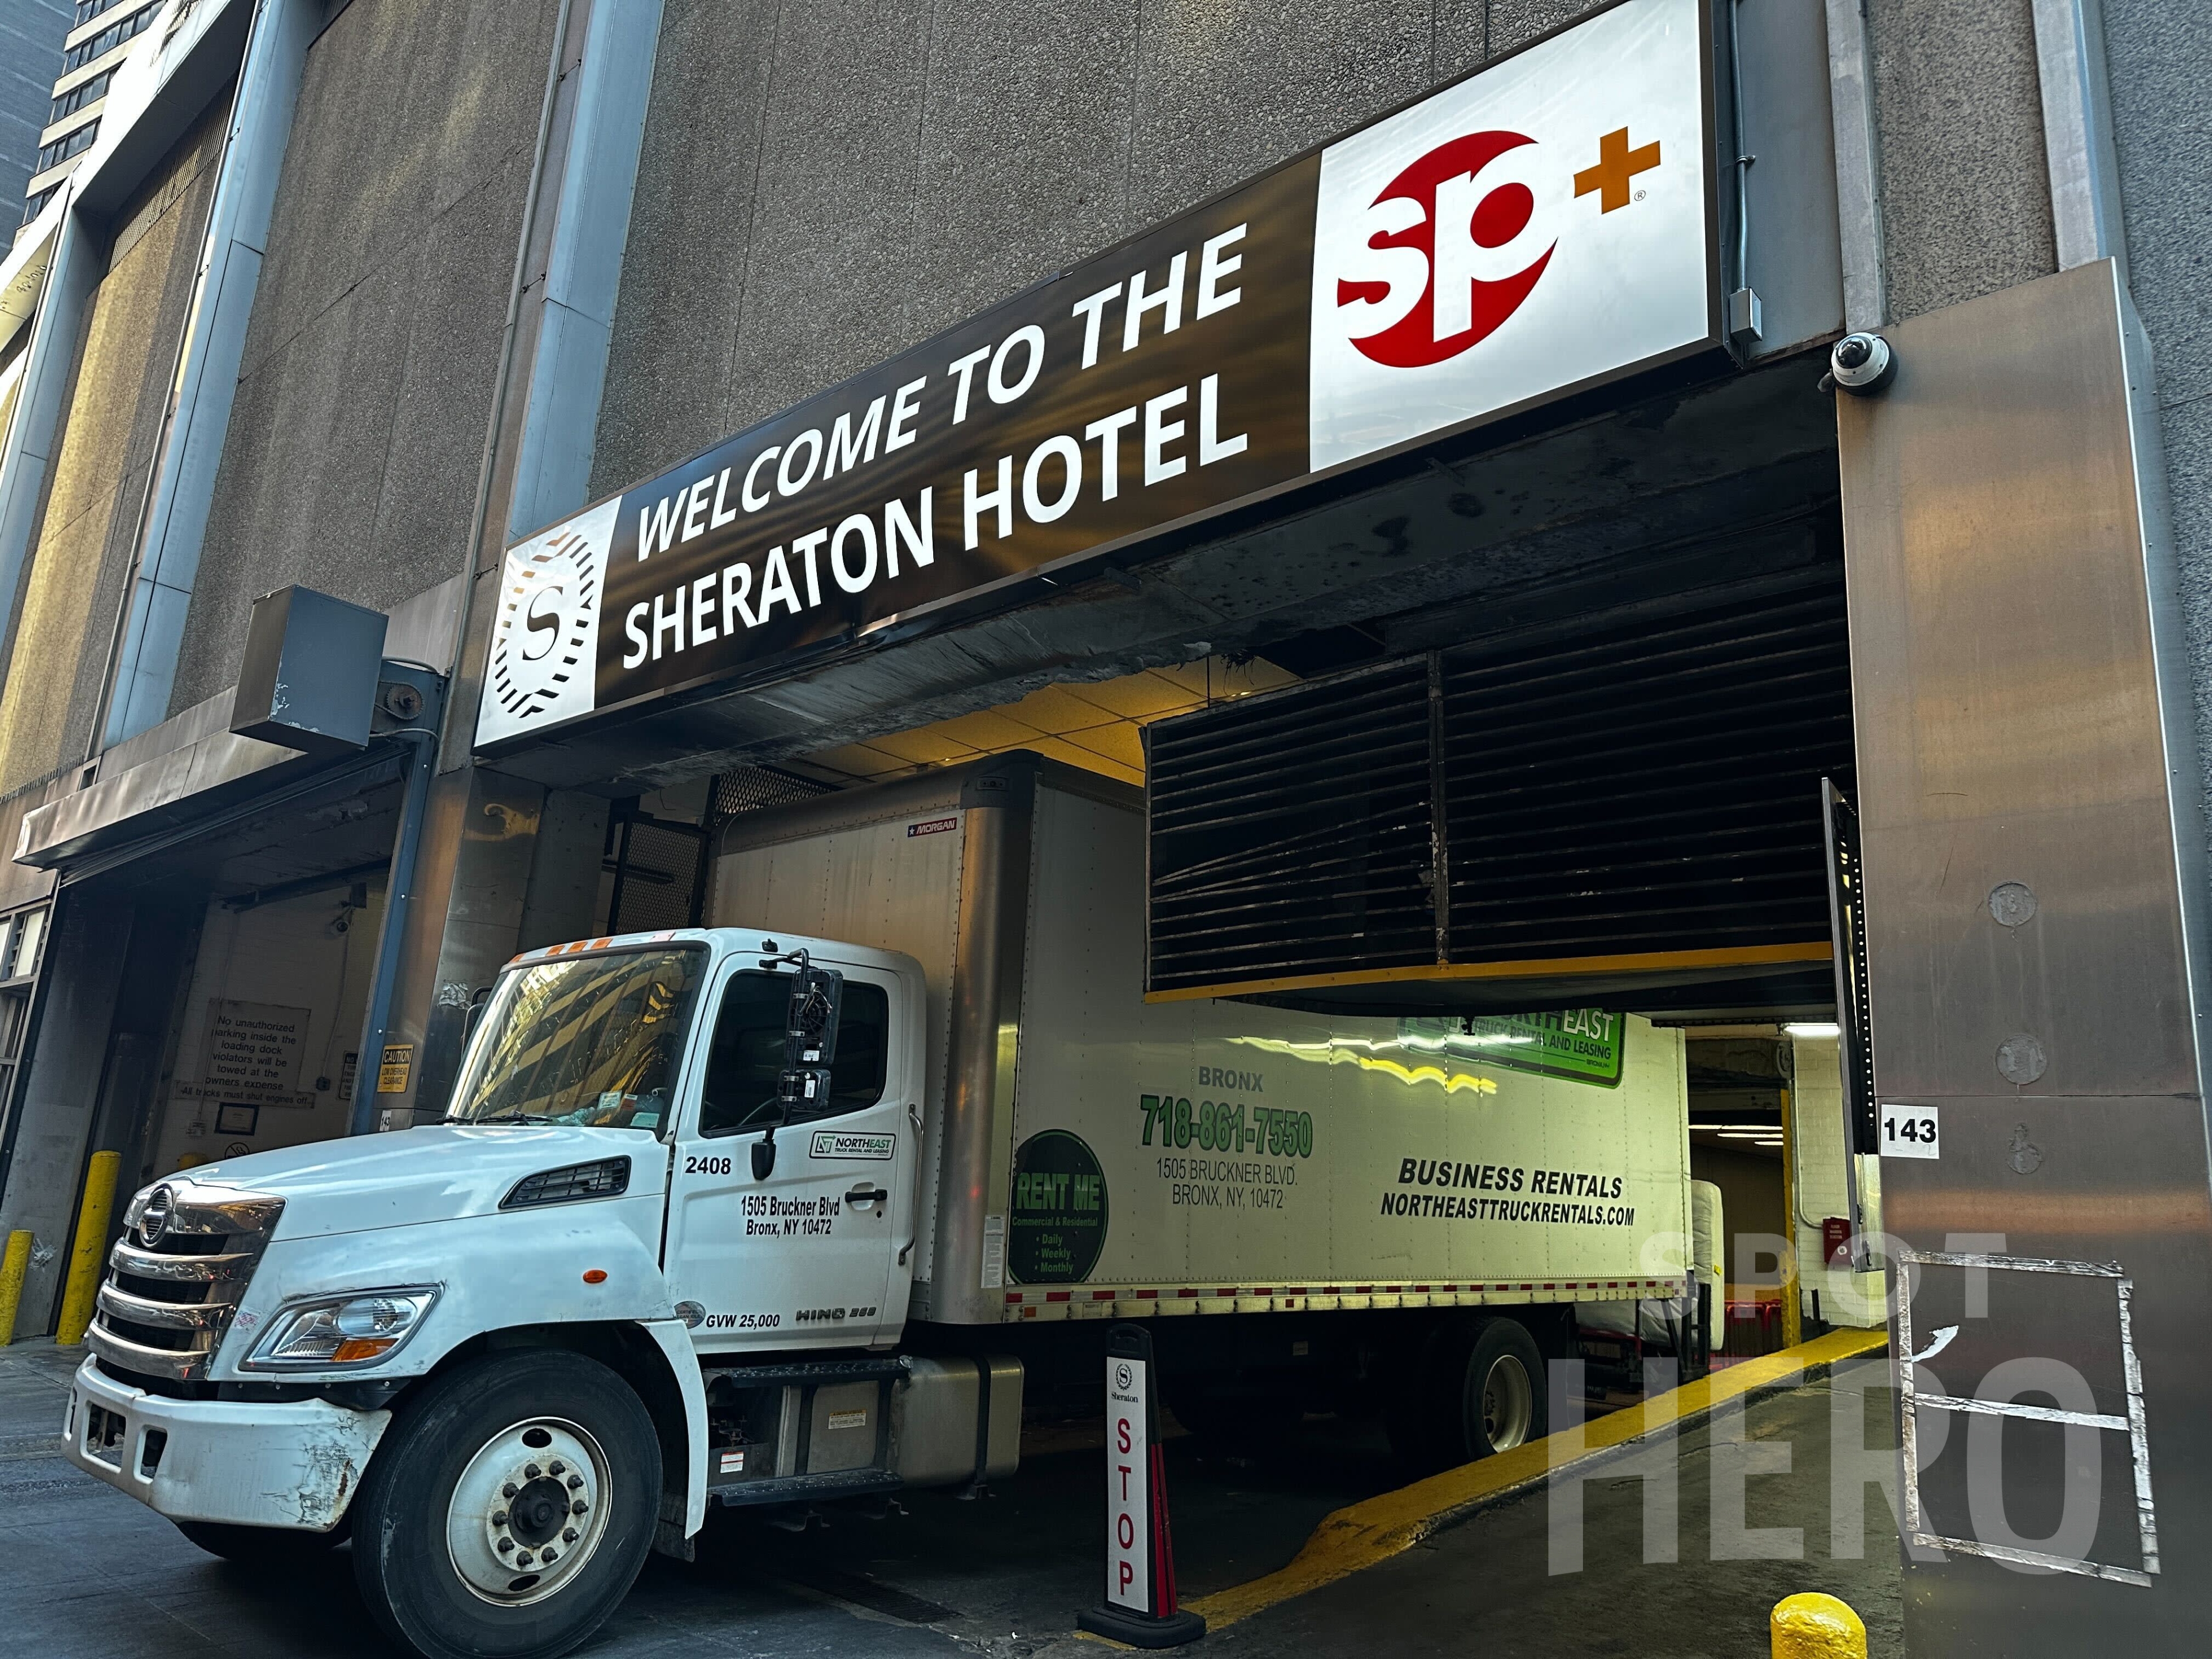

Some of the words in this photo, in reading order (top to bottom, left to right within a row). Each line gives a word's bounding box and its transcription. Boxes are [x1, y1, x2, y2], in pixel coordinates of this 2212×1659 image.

[638, 375, 927, 562] WELCOME
[947, 324, 1046, 426] TO
[1071, 222, 1247, 370] THE
[623, 486, 935, 670] SHERATON
[964, 373, 1248, 551] HOTEL
[522, 585, 564, 661] S
[916, 819, 956, 834] MORGAN
[218, 1016, 231, 1025] No
[236, 1019, 294, 1032] unauthorized
[251, 1031, 278, 1043] inside
[282, 1036, 296, 1045] the
[221, 1040, 255, 1053] loading
[260, 1044, 282, 1055] dock
[1550, 1035, 1571, 1050] AND
[1574, 1040, 1611, 1059] LEASING
[213, 1052, 252, 1063] violators
[257, 1057, 271, 1066] will
[275, 1058, 287, 1067] be
[384, 1050, 410, 1063] CAUTION
[217, 1065, 246, 1075] towed
[251, 1067, 259, 1076] at
[264, 1069, 279, 1078] the
[1199, 1066, 1263, 1093] BRONX
[205, 1077, 240, 1087] owners
[224, 1091, 243, 1099] must
[247, 1092, 262, 1100] shut
[266, 1095, 294, 1104] engines
[1140, 1094, 1313, 1158] 718-861-7550
[1884, 1118, 1936, 1143] 143
[835, 1138, 891, 1149] NORTHEAST
[685, 1156, 732, 1175] 2408
[1157, 1157, 1186, 1179] 1505
[1190, 1159, 1262, 1184] BRUCKNER
[1397, 1157, 1524, 1192] BUSINESS
[1531, 1169, 1623, 1199] RENTALS
[1016, 1172, 1070, 1210] RENT
[1073, 1173, 1101, 1210] ME
[1172, 1183, 1222, 1209] BRONX,
[1250, 1188, 1283, 1209] 10472
[741, 1195, 767, 1217] 1505
[770, 1196, 817, 1217] Bruckner
[819, 1196, 840, 1217] Blvd
[1380, 1192, 1635, 1226] NORTHEASTTRUCKRENTALS.COM
[746, 1219, 780, 1238] Bronx,
[783, 1219, 800, 1234] NY
[802, 1218, 831, 1235] 10472
[1012, 1216, 1054, 1226] Commercial
[1055, 1217, 1060, 1226] &
[1062, 1217, 1098, 1227] Residential
[1041, 1233, 1063, 1247] Daily
[1041, 1248, 1071, 1260] Weekly
[1040, 1262, 1073, 1274] Monthly
[706, 1315, 737, 1328] GVW
[739, 1315, 780, 1330] 25,000
[796, 1308, 846, 1321] HINO
[1111, 1391, 1138, 1403] Sheraton
[1117, 1418, 1135, 1596] STOP
